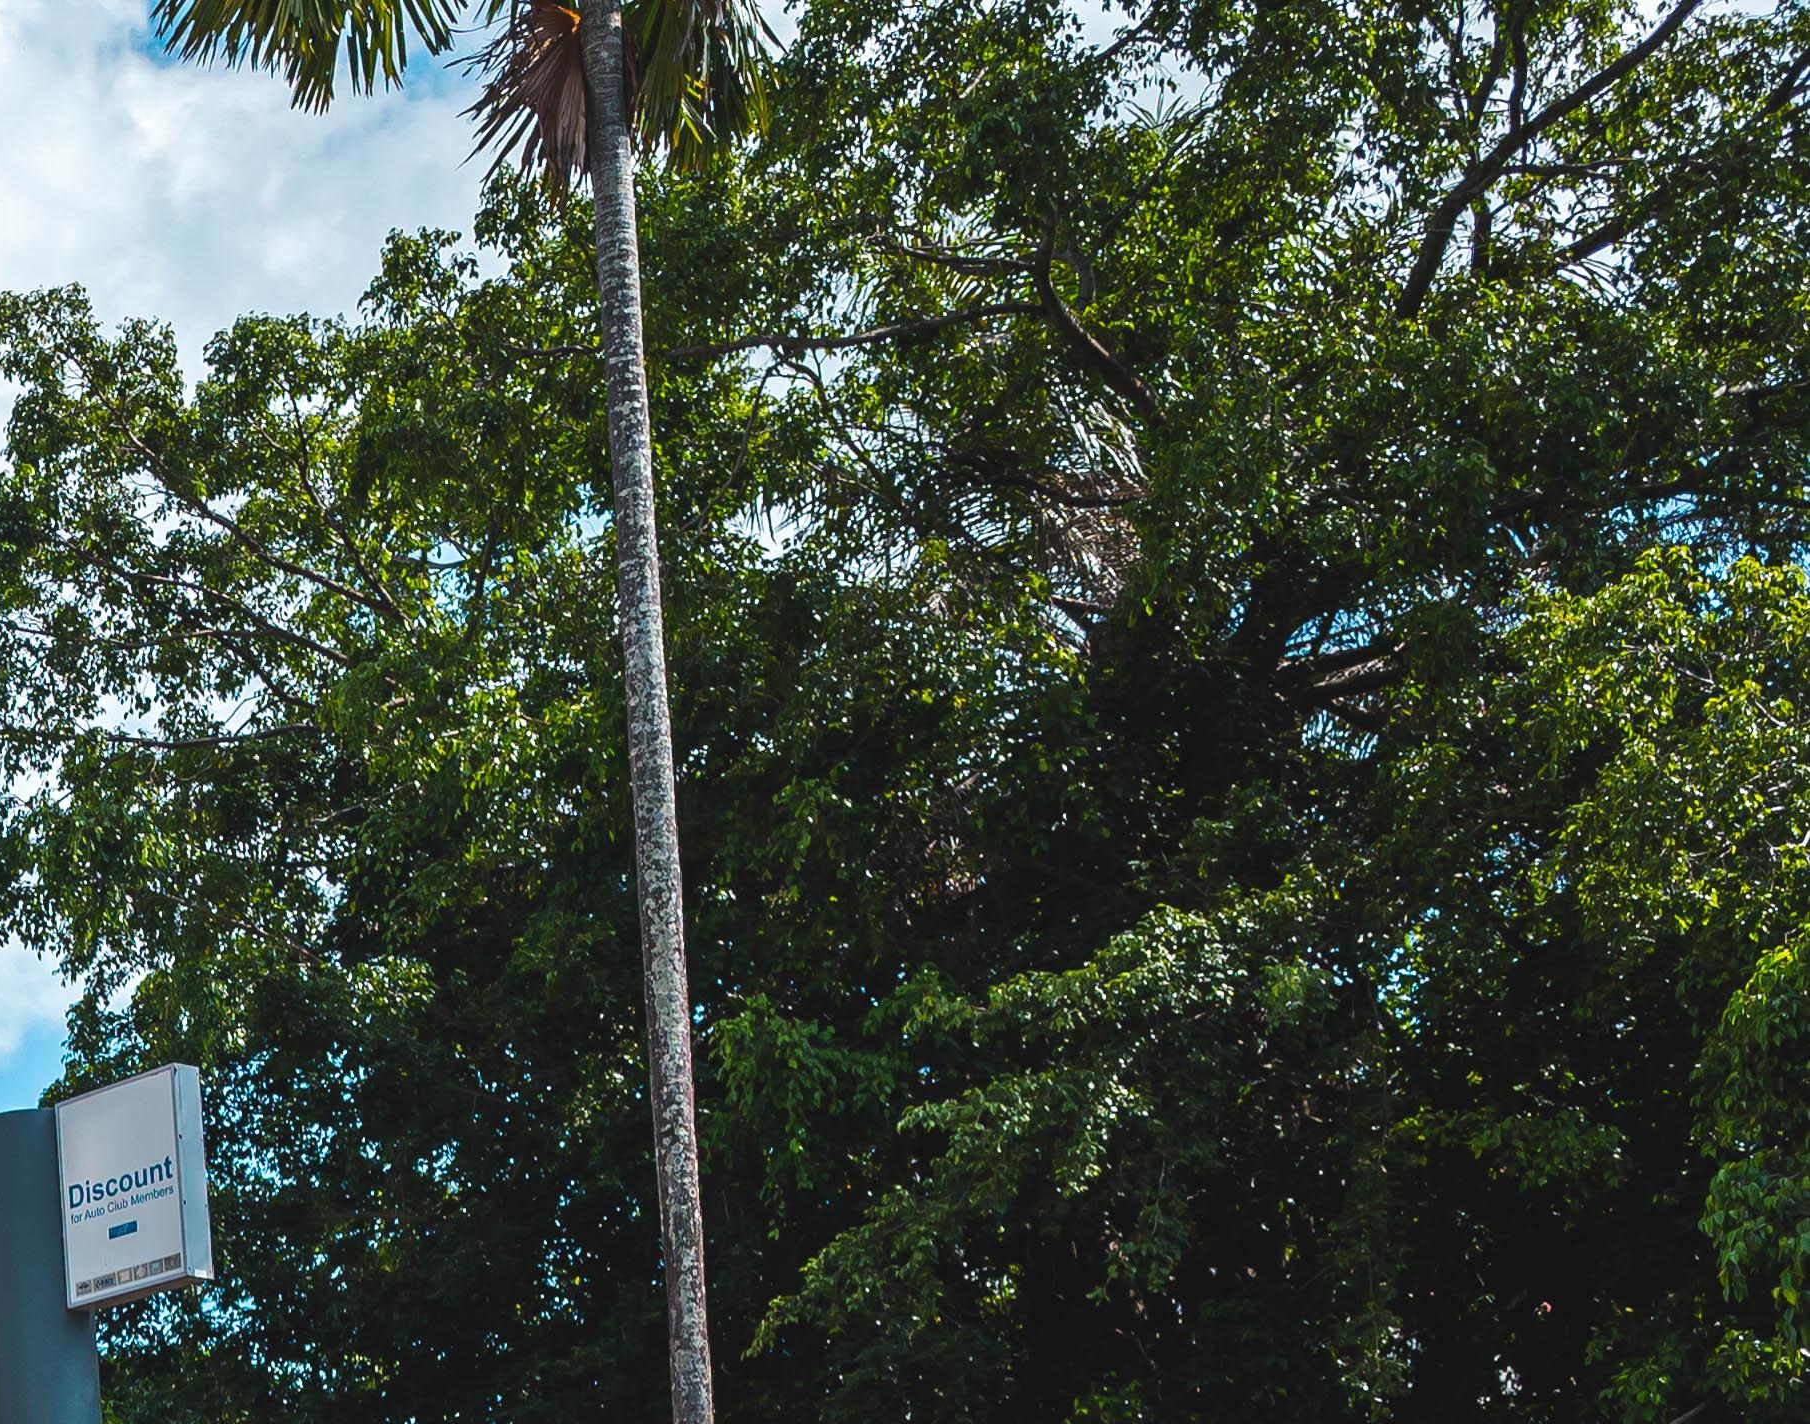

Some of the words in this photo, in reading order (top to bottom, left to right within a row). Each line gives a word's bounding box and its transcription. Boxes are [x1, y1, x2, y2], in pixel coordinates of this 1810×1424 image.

[68, 1155, 173, 1209] Discount
[70, 1214, 83, 1224] for
[84, 1207, 105, 1220] Auto
[107, 1198, 129, 1213] Club
[130, 1185, 174, 1206] Members
